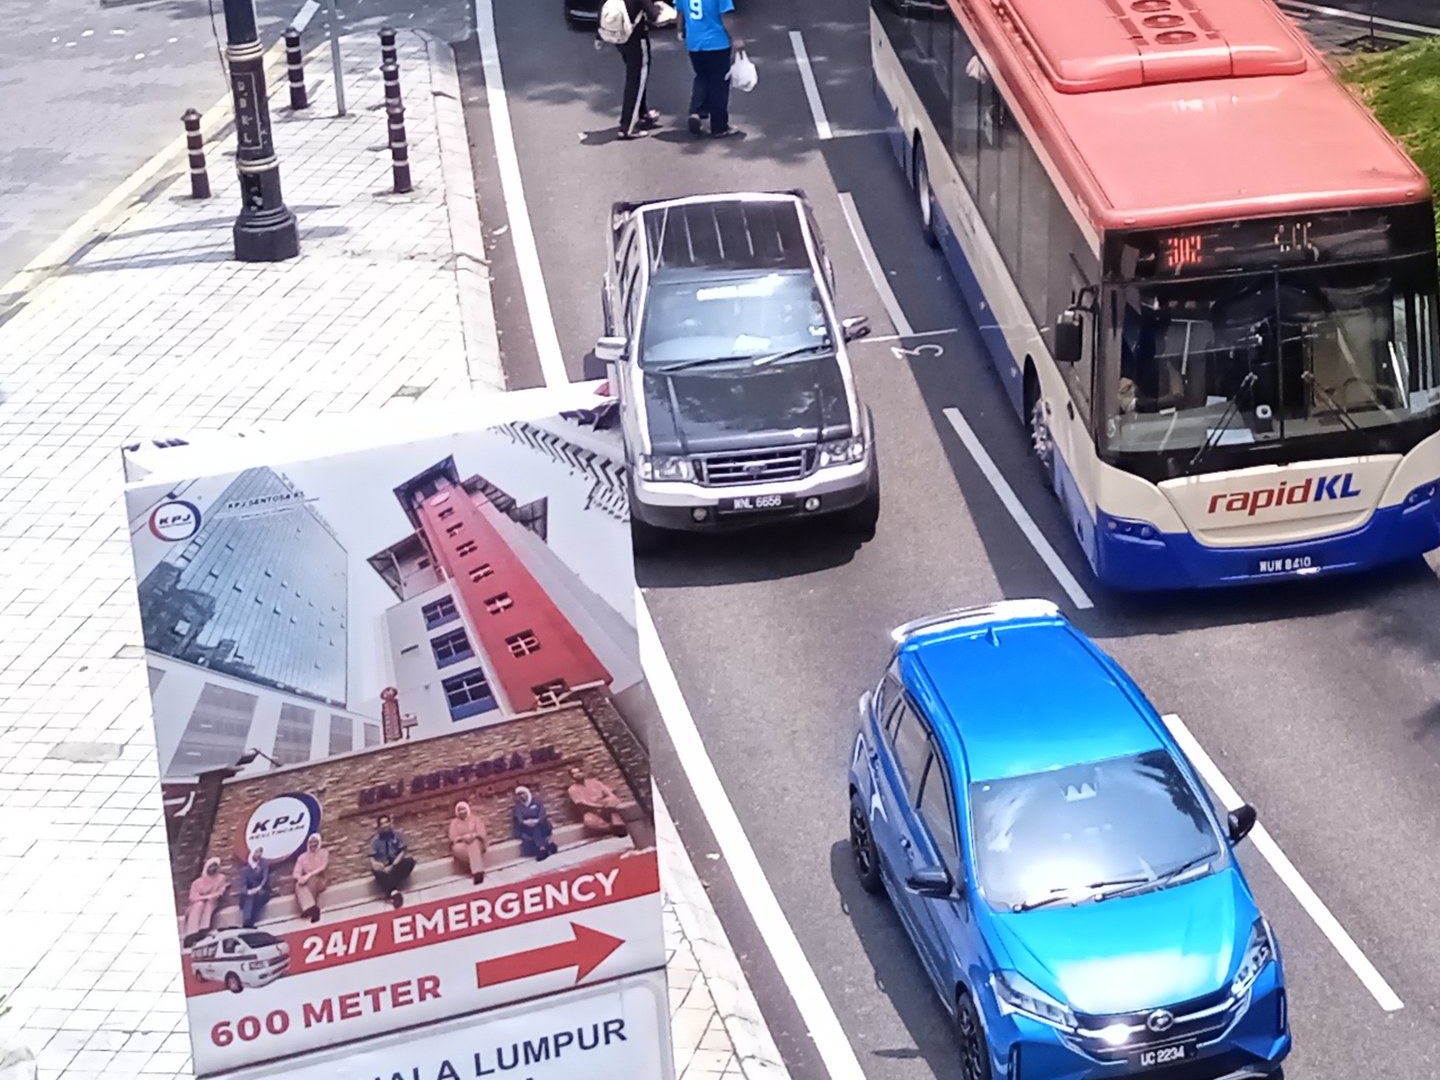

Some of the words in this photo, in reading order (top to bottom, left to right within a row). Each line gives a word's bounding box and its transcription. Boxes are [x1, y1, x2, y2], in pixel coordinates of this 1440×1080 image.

[1208, 472, 1362, 516] rapidKL
[159, 514, 192, 525] KPJ
[252, 812, 305, 834] KPJ
[303, 924, 377, 965] 24/7
[392, 868, 621, 944] EMERGENCY
[210, 1009, 290, 1047] 600
[303, 975, 443, 1029] METER
[474, 1019, 628, 1077] LUMPUR
[1141, 1051, 1156, 1066] UC
[1157, 1045, 1184, 1063] 2234
